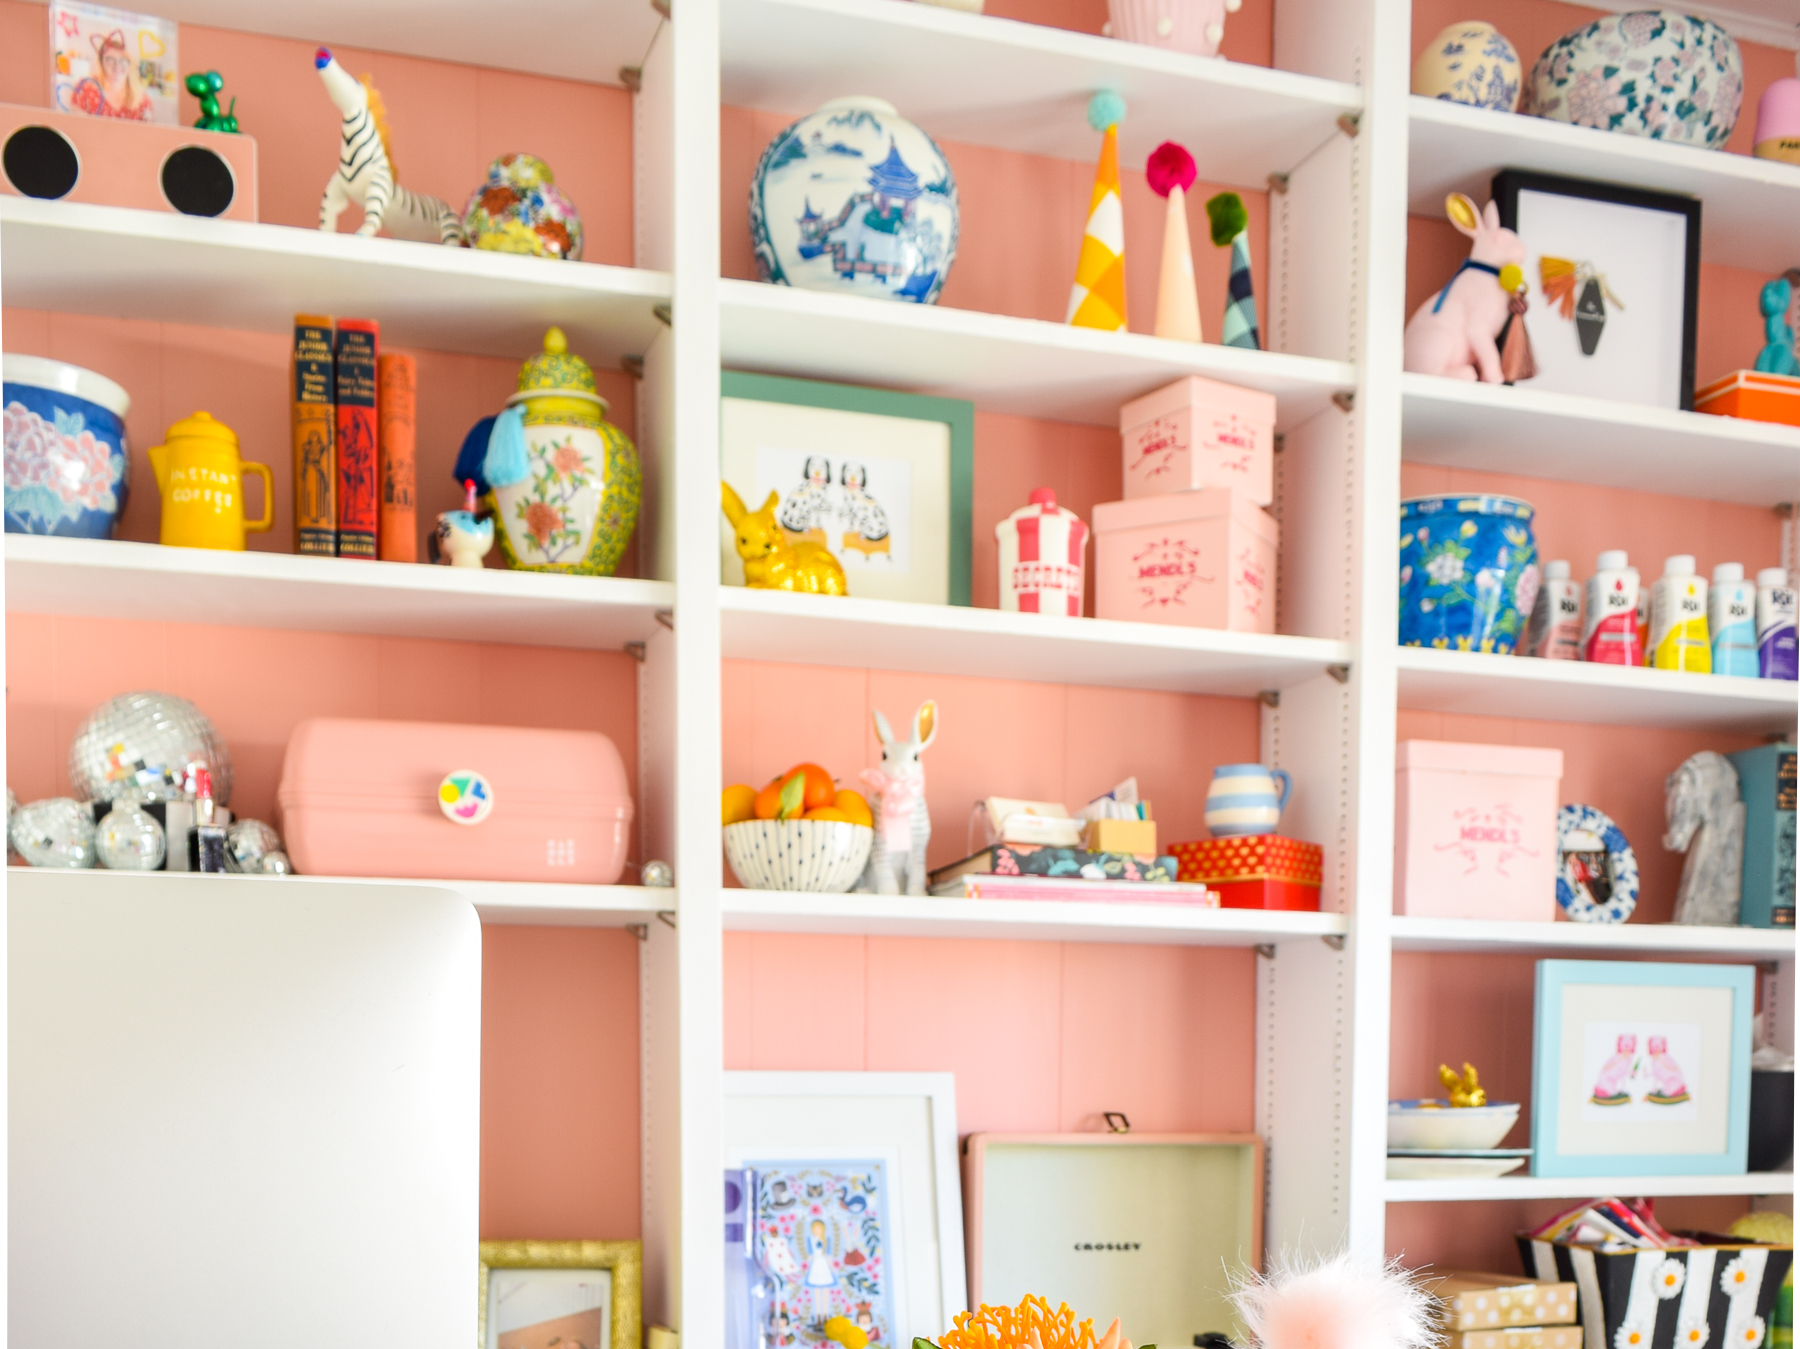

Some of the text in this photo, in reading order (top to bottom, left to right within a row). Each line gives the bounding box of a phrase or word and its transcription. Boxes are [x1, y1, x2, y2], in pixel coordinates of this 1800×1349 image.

[170, 466, 237, 485] INSTANT
[172, 488, 232, 508] COFFEE
[1074, 1242, 1140, 1251] CROSLEY
